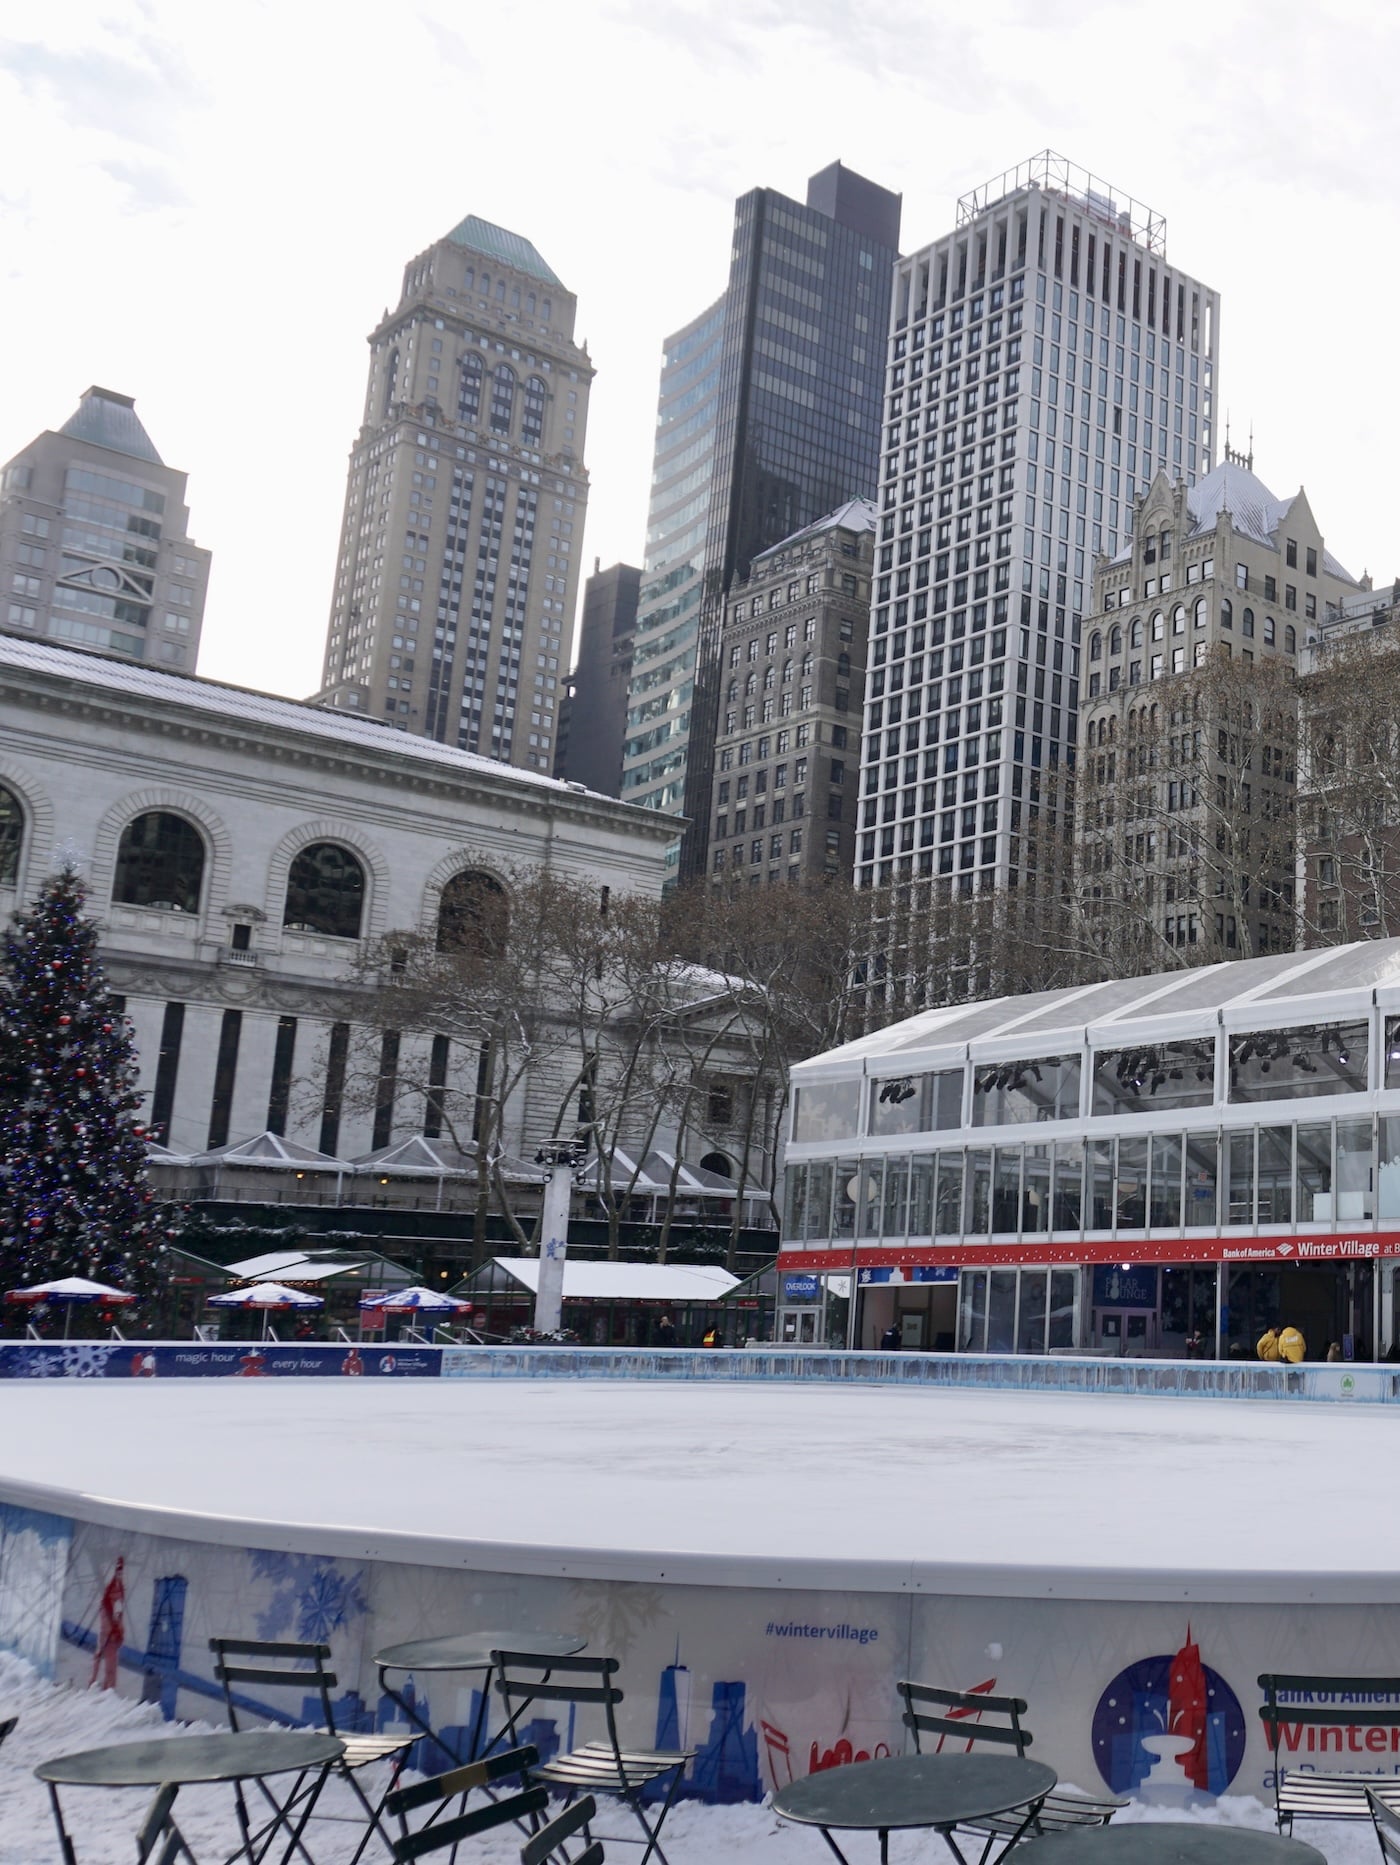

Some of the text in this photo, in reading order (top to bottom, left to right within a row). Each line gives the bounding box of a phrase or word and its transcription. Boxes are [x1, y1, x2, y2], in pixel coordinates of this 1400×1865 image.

[1222, 1248, 1240, 1258] Bank
[1240, 1248, 1248, 1257] of
[1248, 1247, 1276, 1257] America
[1297, 1242, 1337, 1257] Winter
[1338, 1240, 1380, 1258] Village
[1383, 1245, 1394, 1254] at
[785, 1282, 816, 1291] OVERLOOK
[175, 1351, 236, 1365] magic hour
[272, 1358, 323, 1371] every hour
[766, 1621, 878, 1645] #wintervillage
